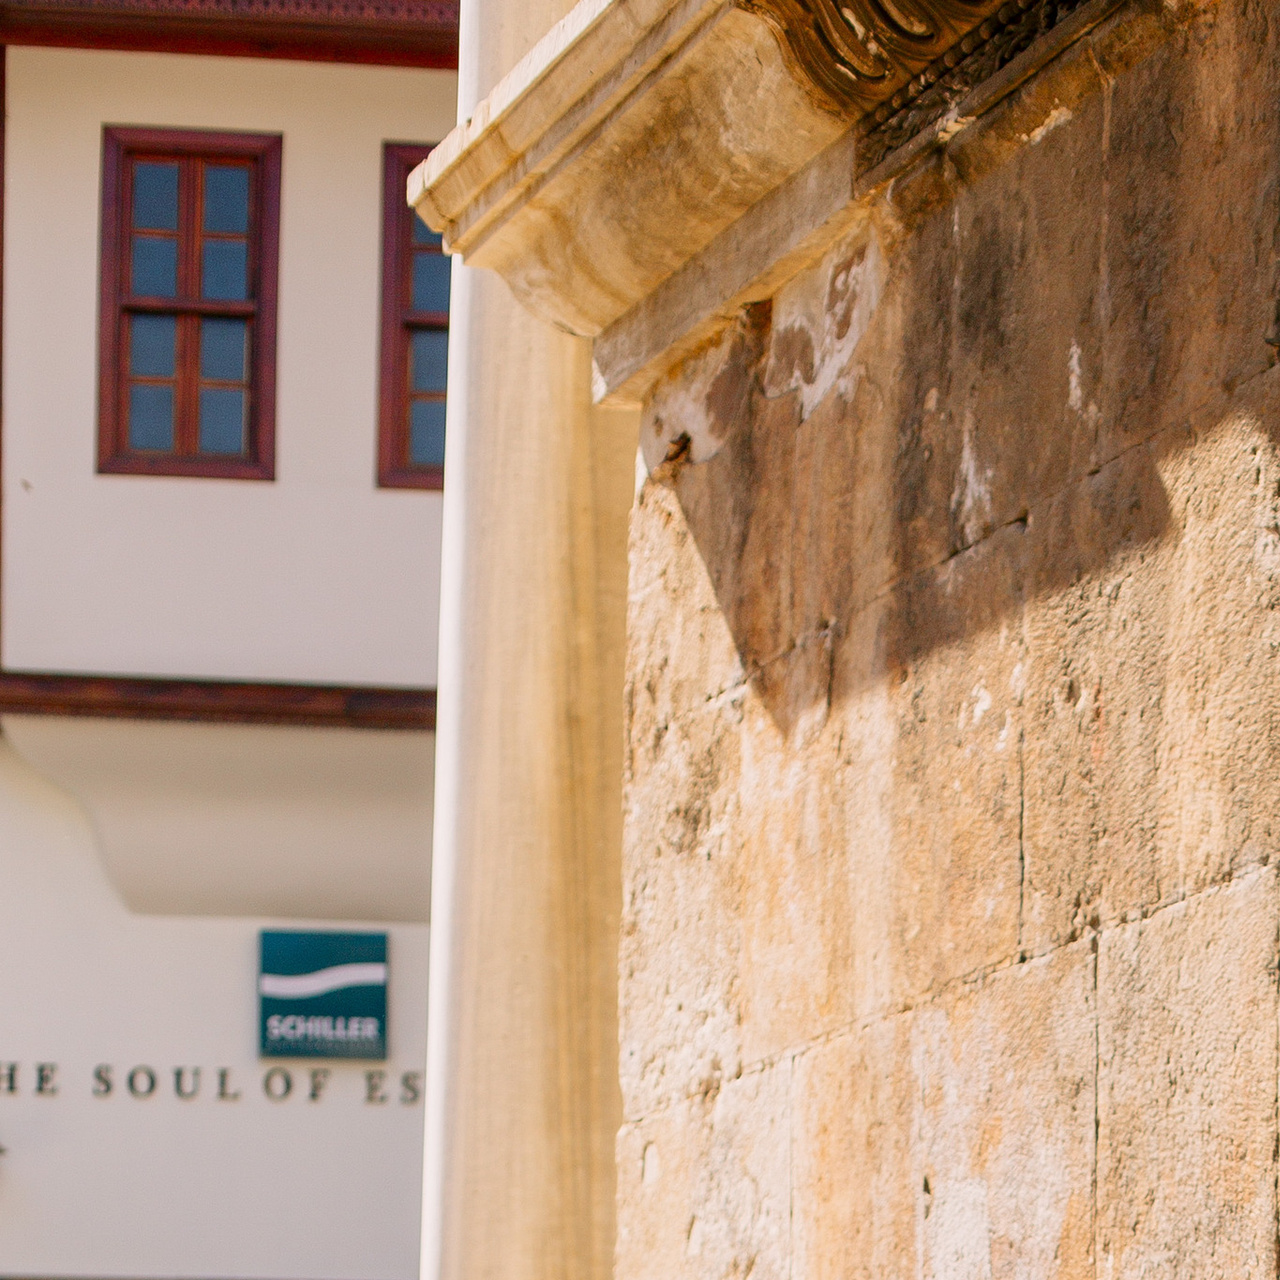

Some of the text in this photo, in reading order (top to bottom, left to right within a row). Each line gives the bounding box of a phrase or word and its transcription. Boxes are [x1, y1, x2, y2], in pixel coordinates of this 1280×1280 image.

[266, 1014, 379, 1040] SCHILLER
[92, 1063, 241, 1100] SOUL
[263, 1066, 331, 1101] OF
[364, 1069, 420, 1103] ES
